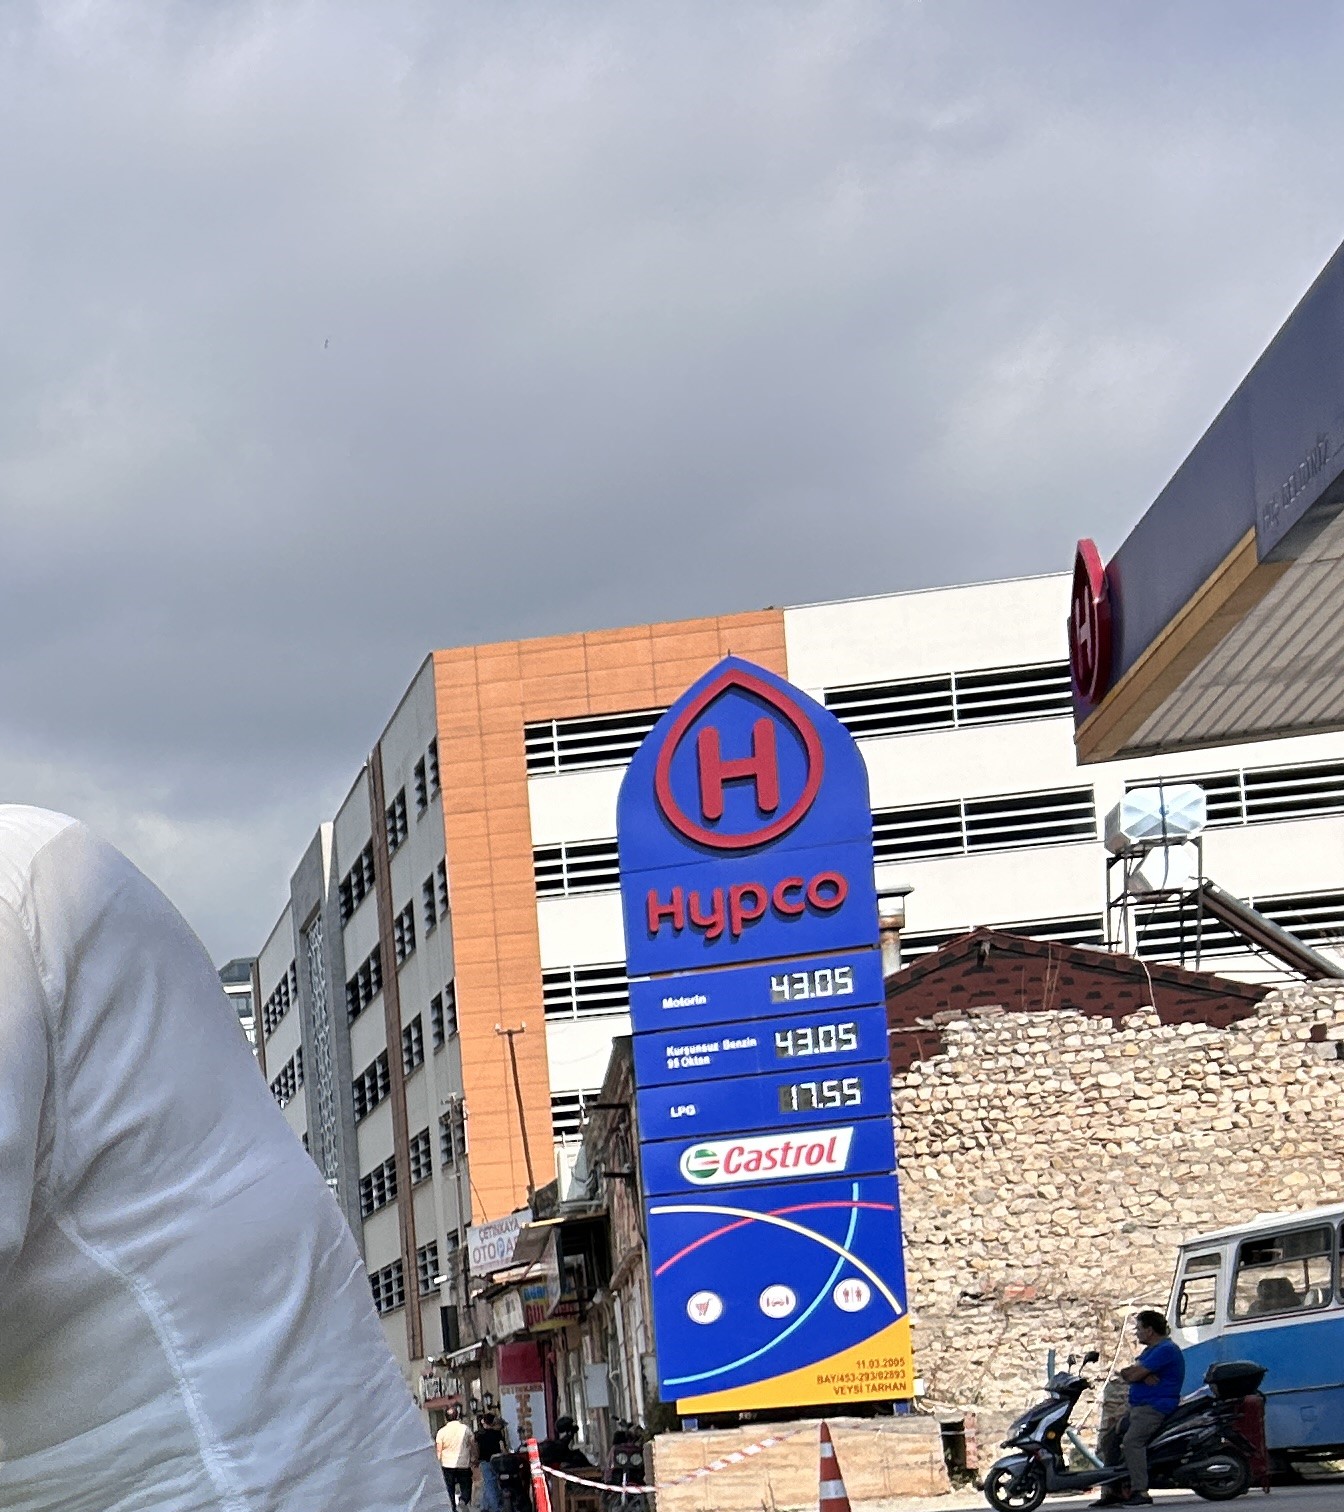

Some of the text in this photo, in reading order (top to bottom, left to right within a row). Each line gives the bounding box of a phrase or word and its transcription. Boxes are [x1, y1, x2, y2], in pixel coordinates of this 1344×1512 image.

[1075, 585, 1093, 681] H
[697, 716, 780, 821] H
[646, 870, 849, 940] Hypco
[662, 966, 854, 1009] Motorin 43.05
[722, 1036, 758, 1051] Benzin
[775, 1022, 857, 1056] 43.05
[666, 1055, 711, 1070] 95 Oktan
[669, 1077, 861, 1118] LPG 17.55
[723, 1135, 837, 1176] Castrol
[472, 1236, 518, 1264] OTOPA
[855, 1357, 906, 1369] 11.03.2005
[833, 1380, 907, 1396] VEYSİ TARHAN
